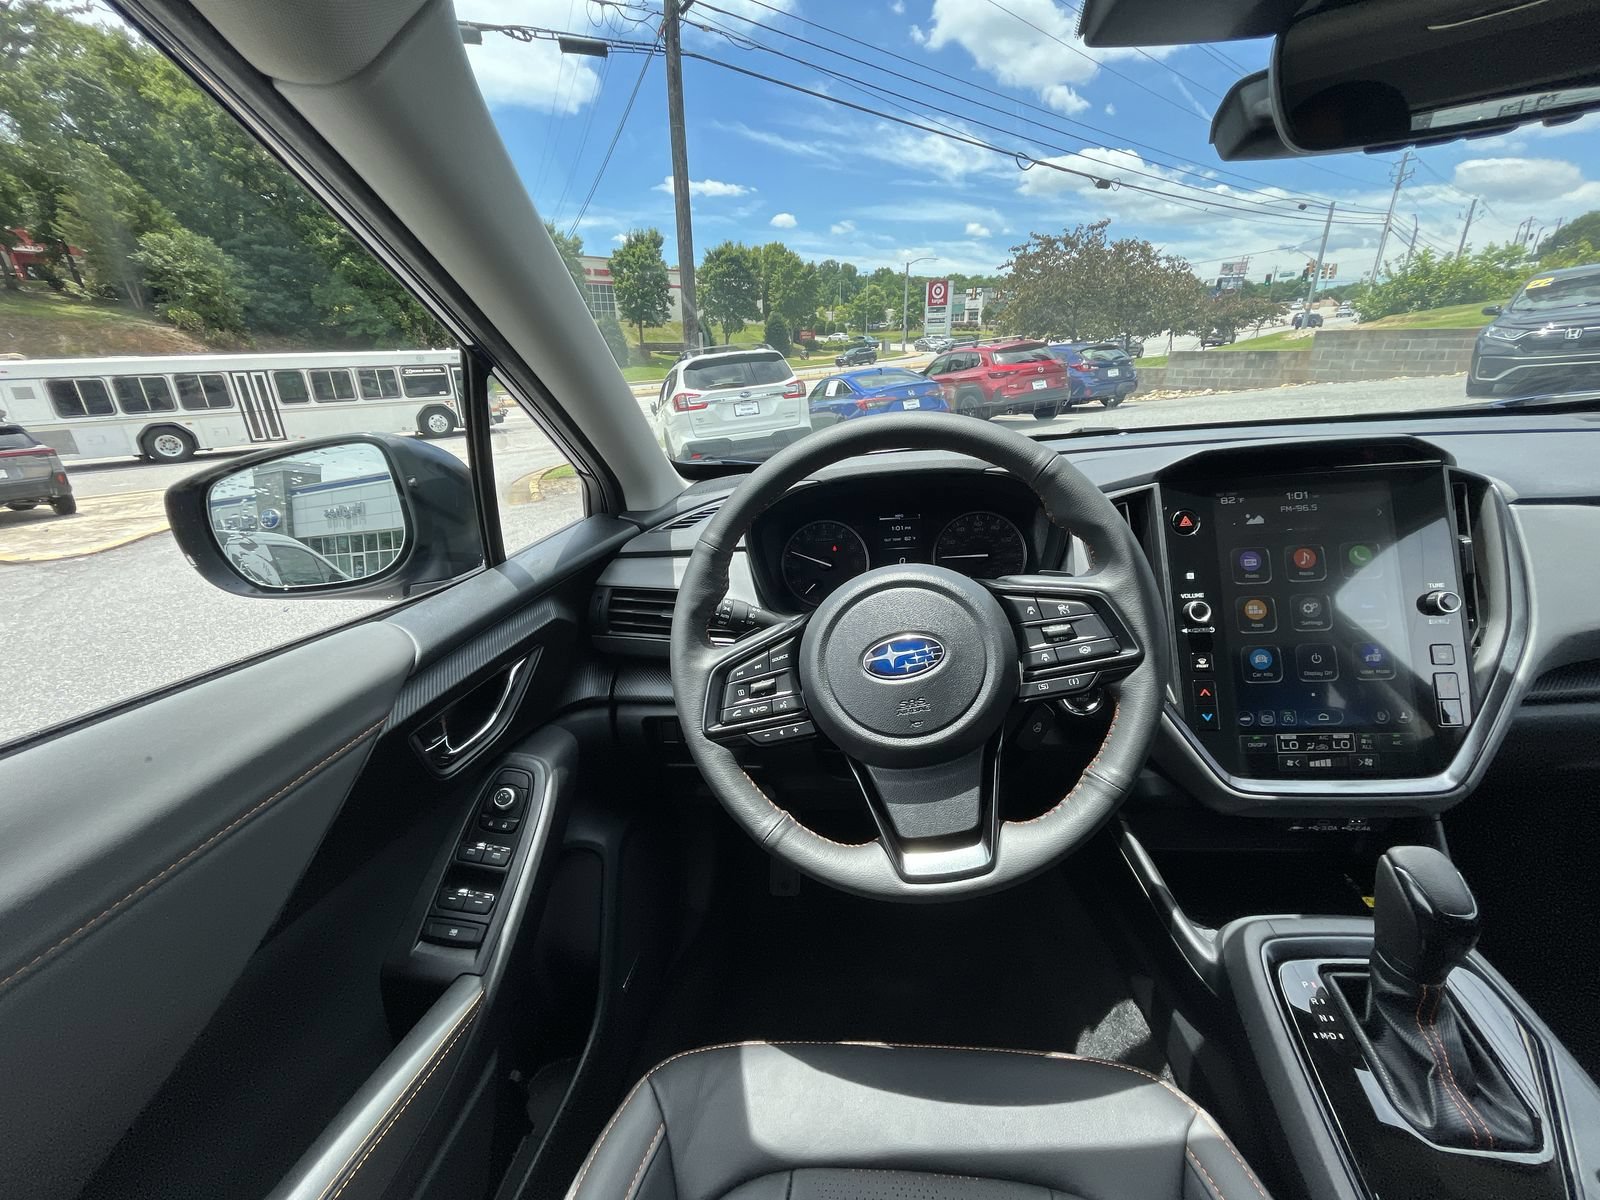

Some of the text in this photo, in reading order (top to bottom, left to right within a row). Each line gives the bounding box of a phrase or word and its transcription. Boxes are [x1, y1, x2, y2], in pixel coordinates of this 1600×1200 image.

[1285, 491, 1308, 500] 1:01
[1220, 496, 1236, 505] 82
[772, 653, 789, 662] SOURCE
[1281, 741, 1299, 750] LO
[1332, 740, 1350, 749] LO
[1311, 997, 1318, 1005] R
[1319, 1014, 1328, 1022] N
